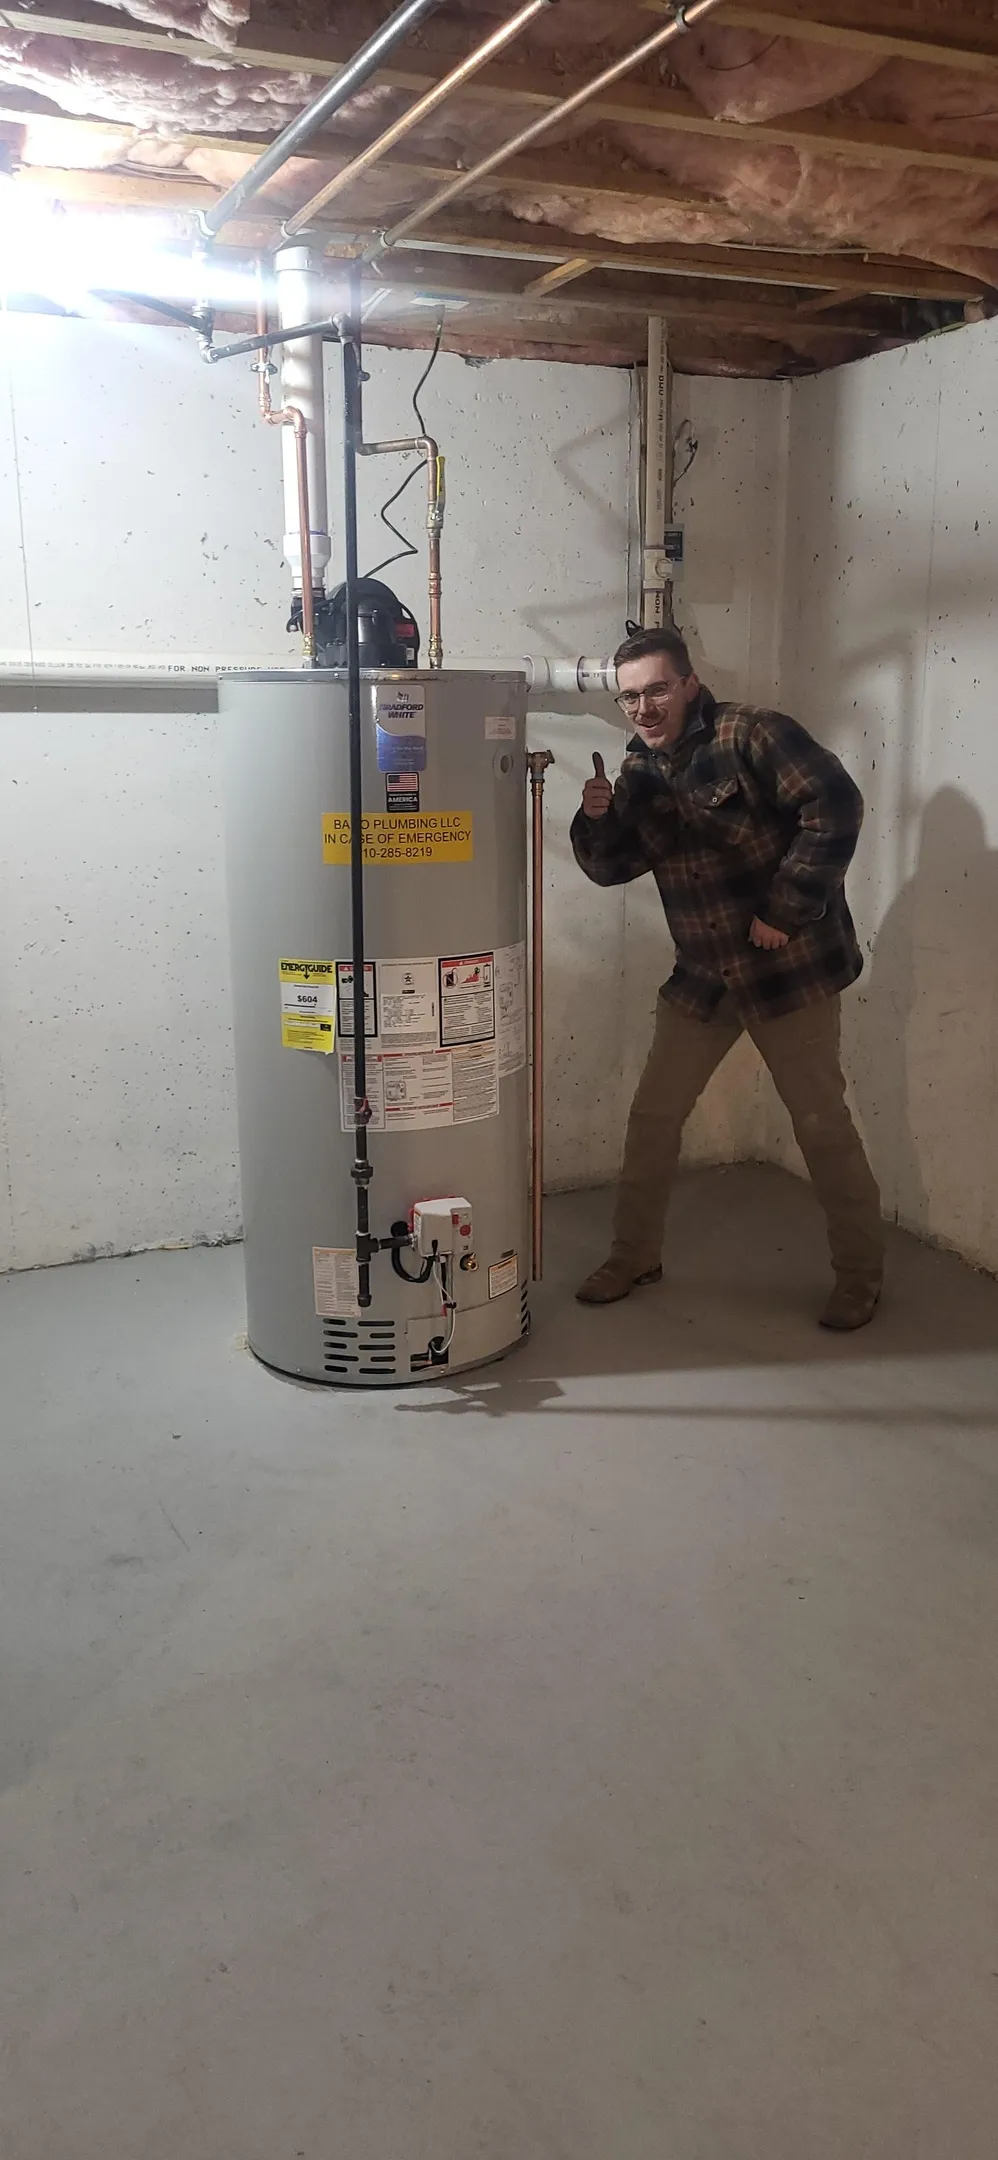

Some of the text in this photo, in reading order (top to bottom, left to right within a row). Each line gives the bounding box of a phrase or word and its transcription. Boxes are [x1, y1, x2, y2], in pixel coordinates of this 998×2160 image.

[388, 711, 416, 719] WHITE
[334, 817, 461, 830] BAO PLUMBING LLC
[324, 831, 472, 844] IN CSE OF EMERGENCY
[359, 847, 433, 858] 10-285-8219
[297, 995, 318, 1003] $604
